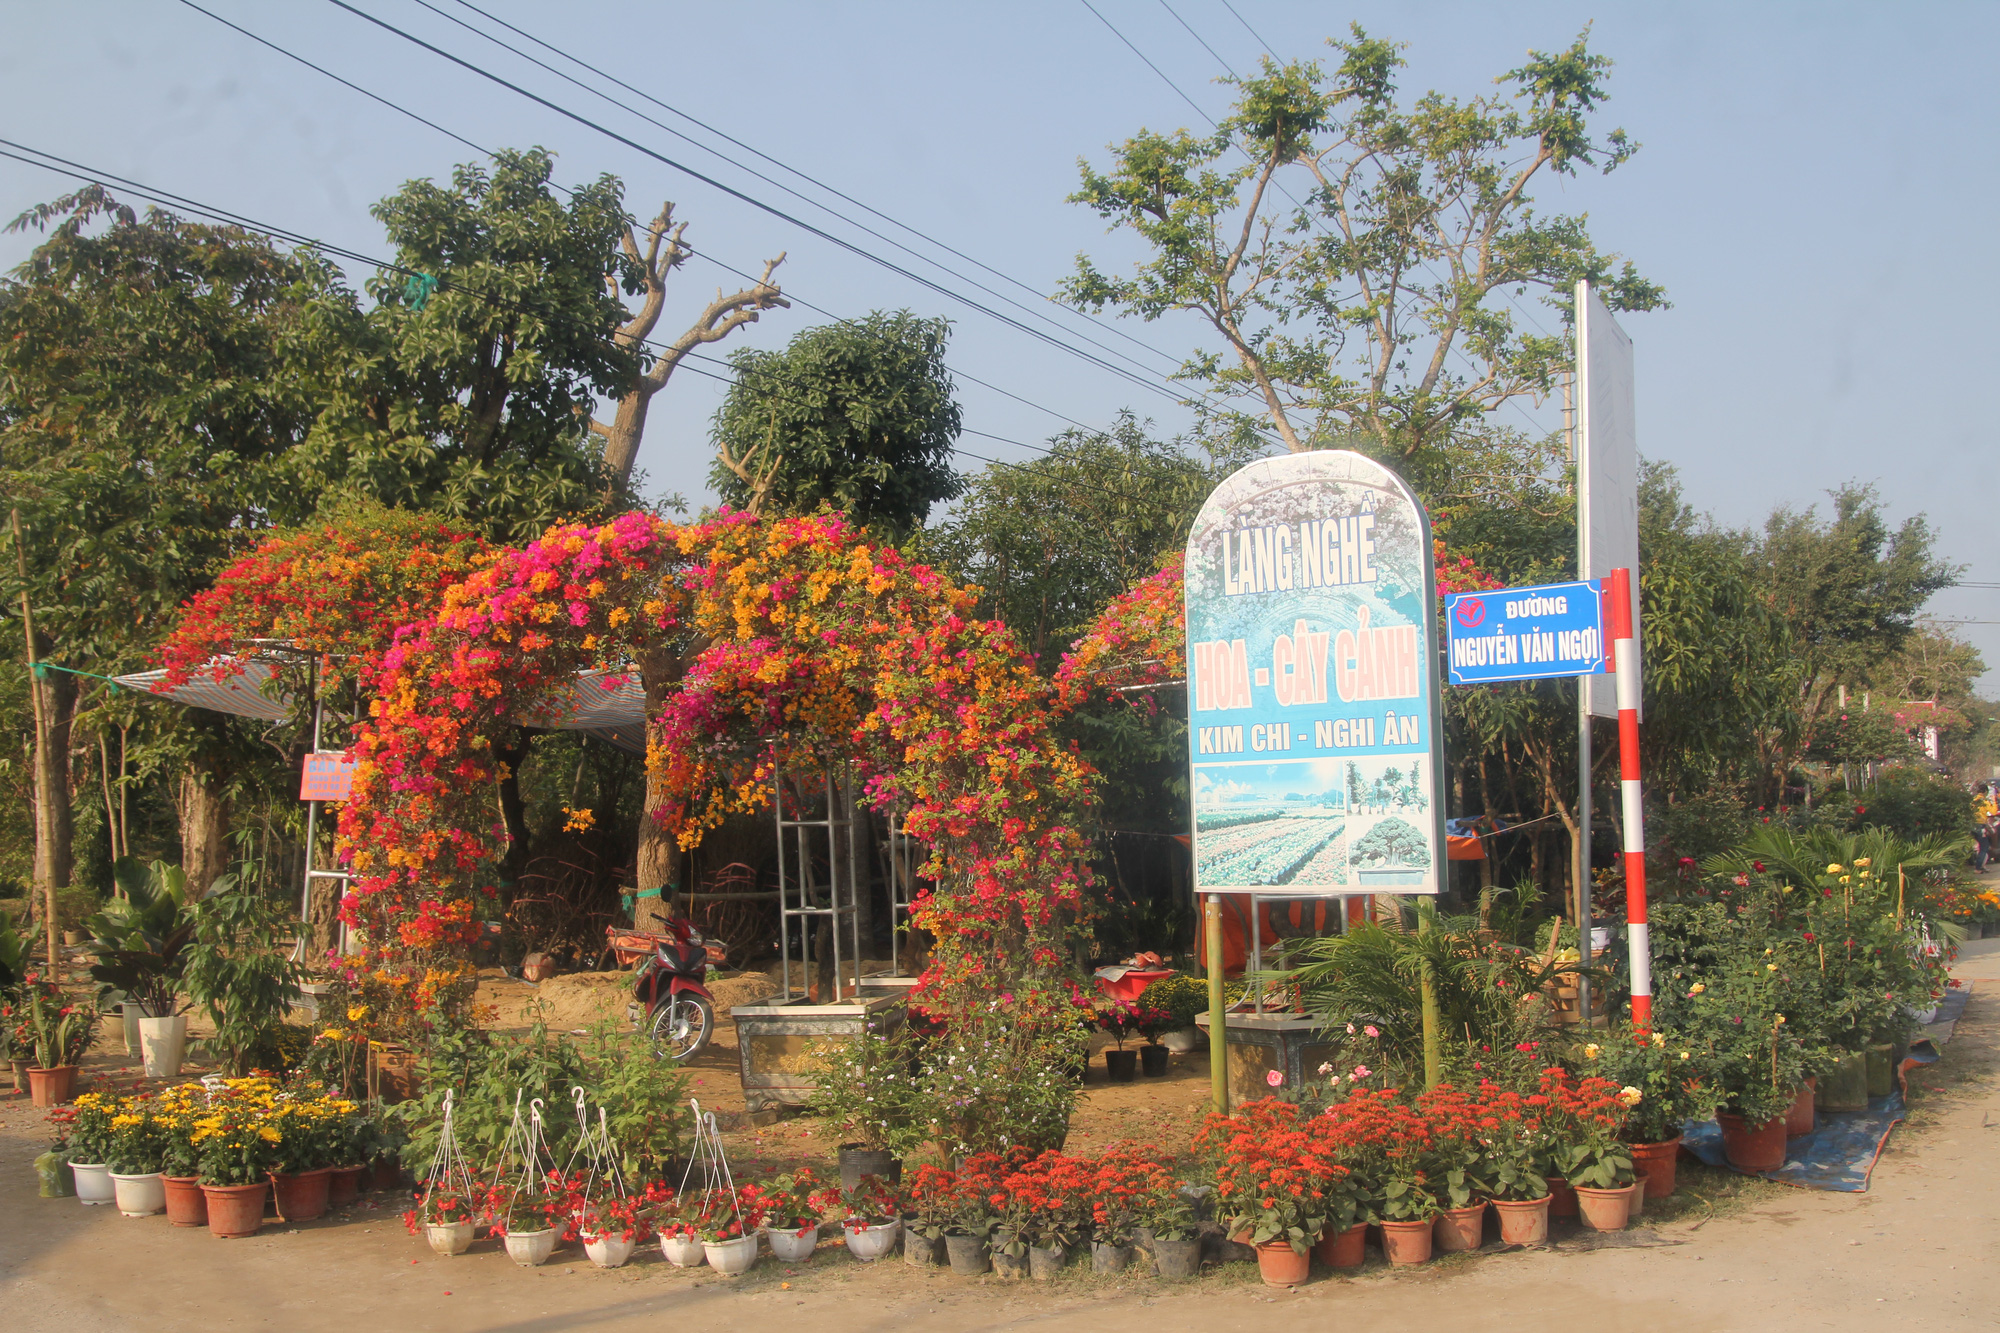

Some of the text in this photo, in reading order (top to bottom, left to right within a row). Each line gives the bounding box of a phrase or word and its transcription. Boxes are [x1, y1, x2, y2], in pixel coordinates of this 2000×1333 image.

[1222, 490, 1377, 597] LÀNG NGHỀ
[1506, 593, 1568, 619] ĐƯỜNG
[1194, 638, 1253, 711] HOA
[1273, 618, 1330, 707] CÂY
[1334, 604, 1420, 703] CẢNH
[1454, 624, 1598, 668] NGUYỄN VĂN NGỢI
[1198, 724, 1244, 755] KIM
[1251, 722, 1291, 753] CHI
[1314, 717, 1375, 749] NGHI
[1382, 709, 1420, 747] ÂN
